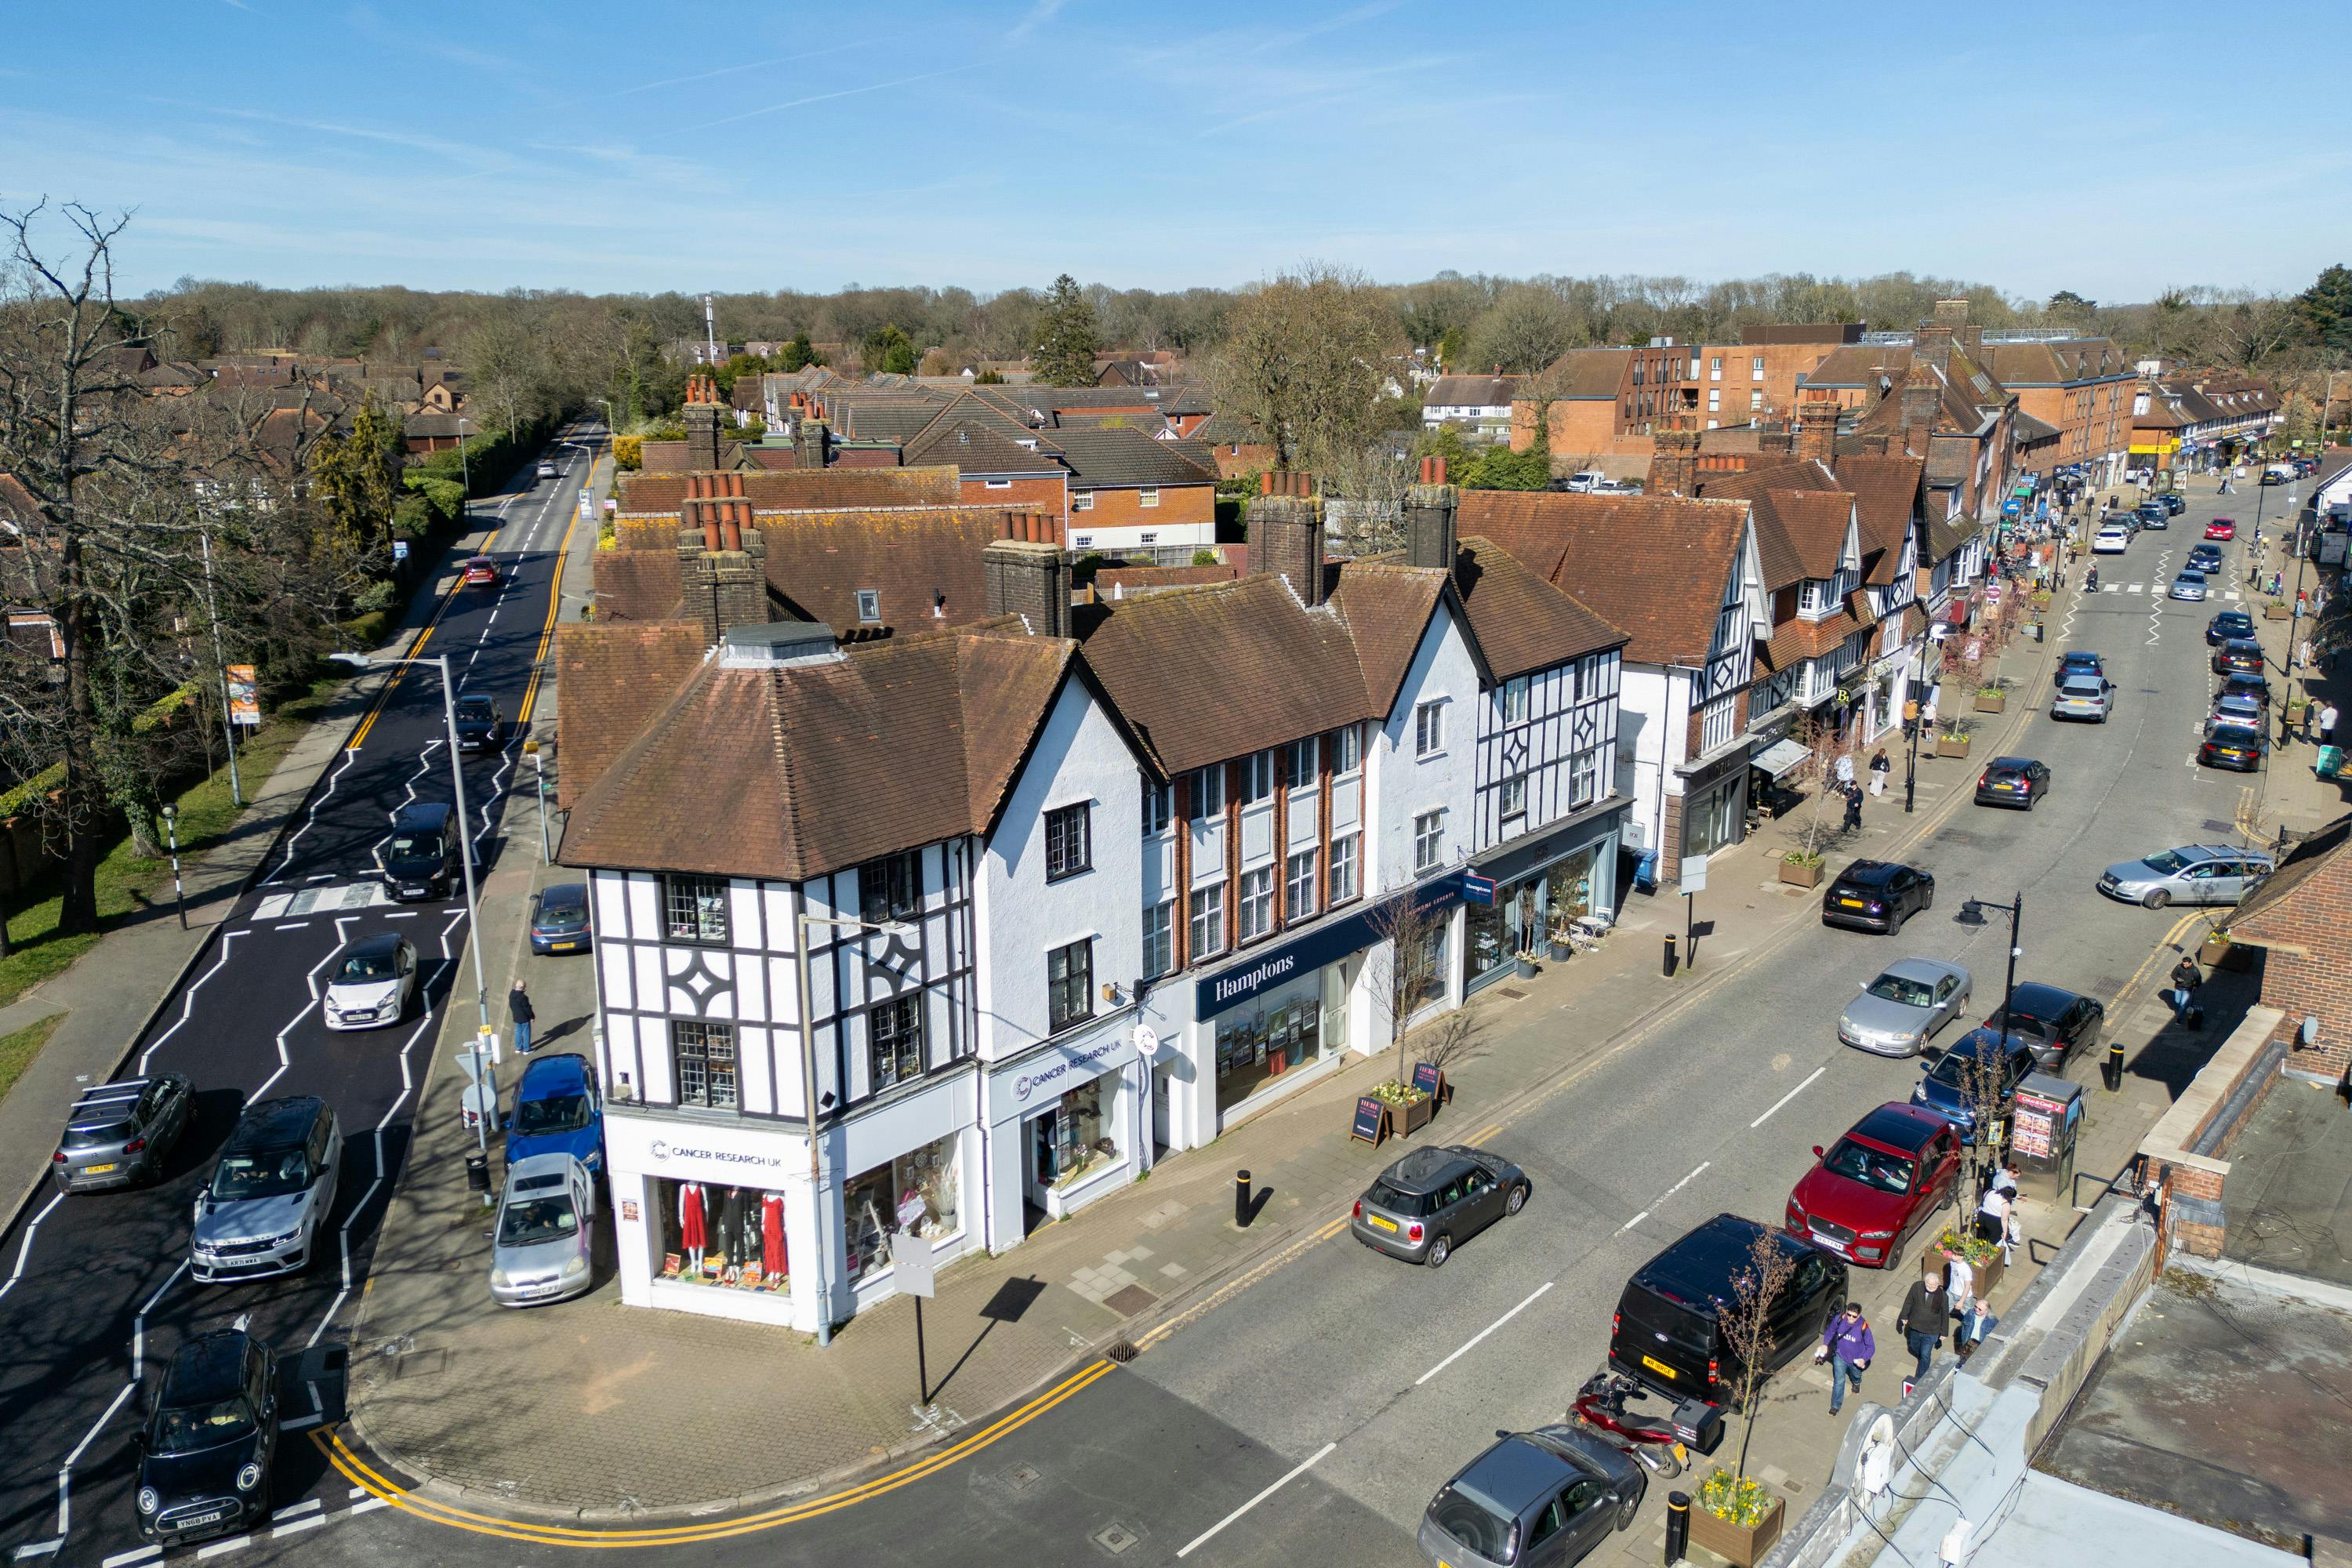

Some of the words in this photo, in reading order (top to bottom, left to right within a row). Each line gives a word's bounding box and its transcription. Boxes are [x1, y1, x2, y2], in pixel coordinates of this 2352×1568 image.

[1465, 882, 1491, 893] Hamptons
[1433, 891, 1456, 905] EXPERTS
[1215, 955, 1294, 1002] Hamptons
[1033, 1064, 1067, 1087] CANCER
[1069, 1044, 1110, 1071] RESEARCH
[1111, 1039, 1123, 1053] UK
[673, 1147, 712, 1160] CANCER
[715, 1152, 765, 1166] RESEARCH
[768, 1158, 782, 1167] UK
[180, 1518, 201, 1527] YN68
